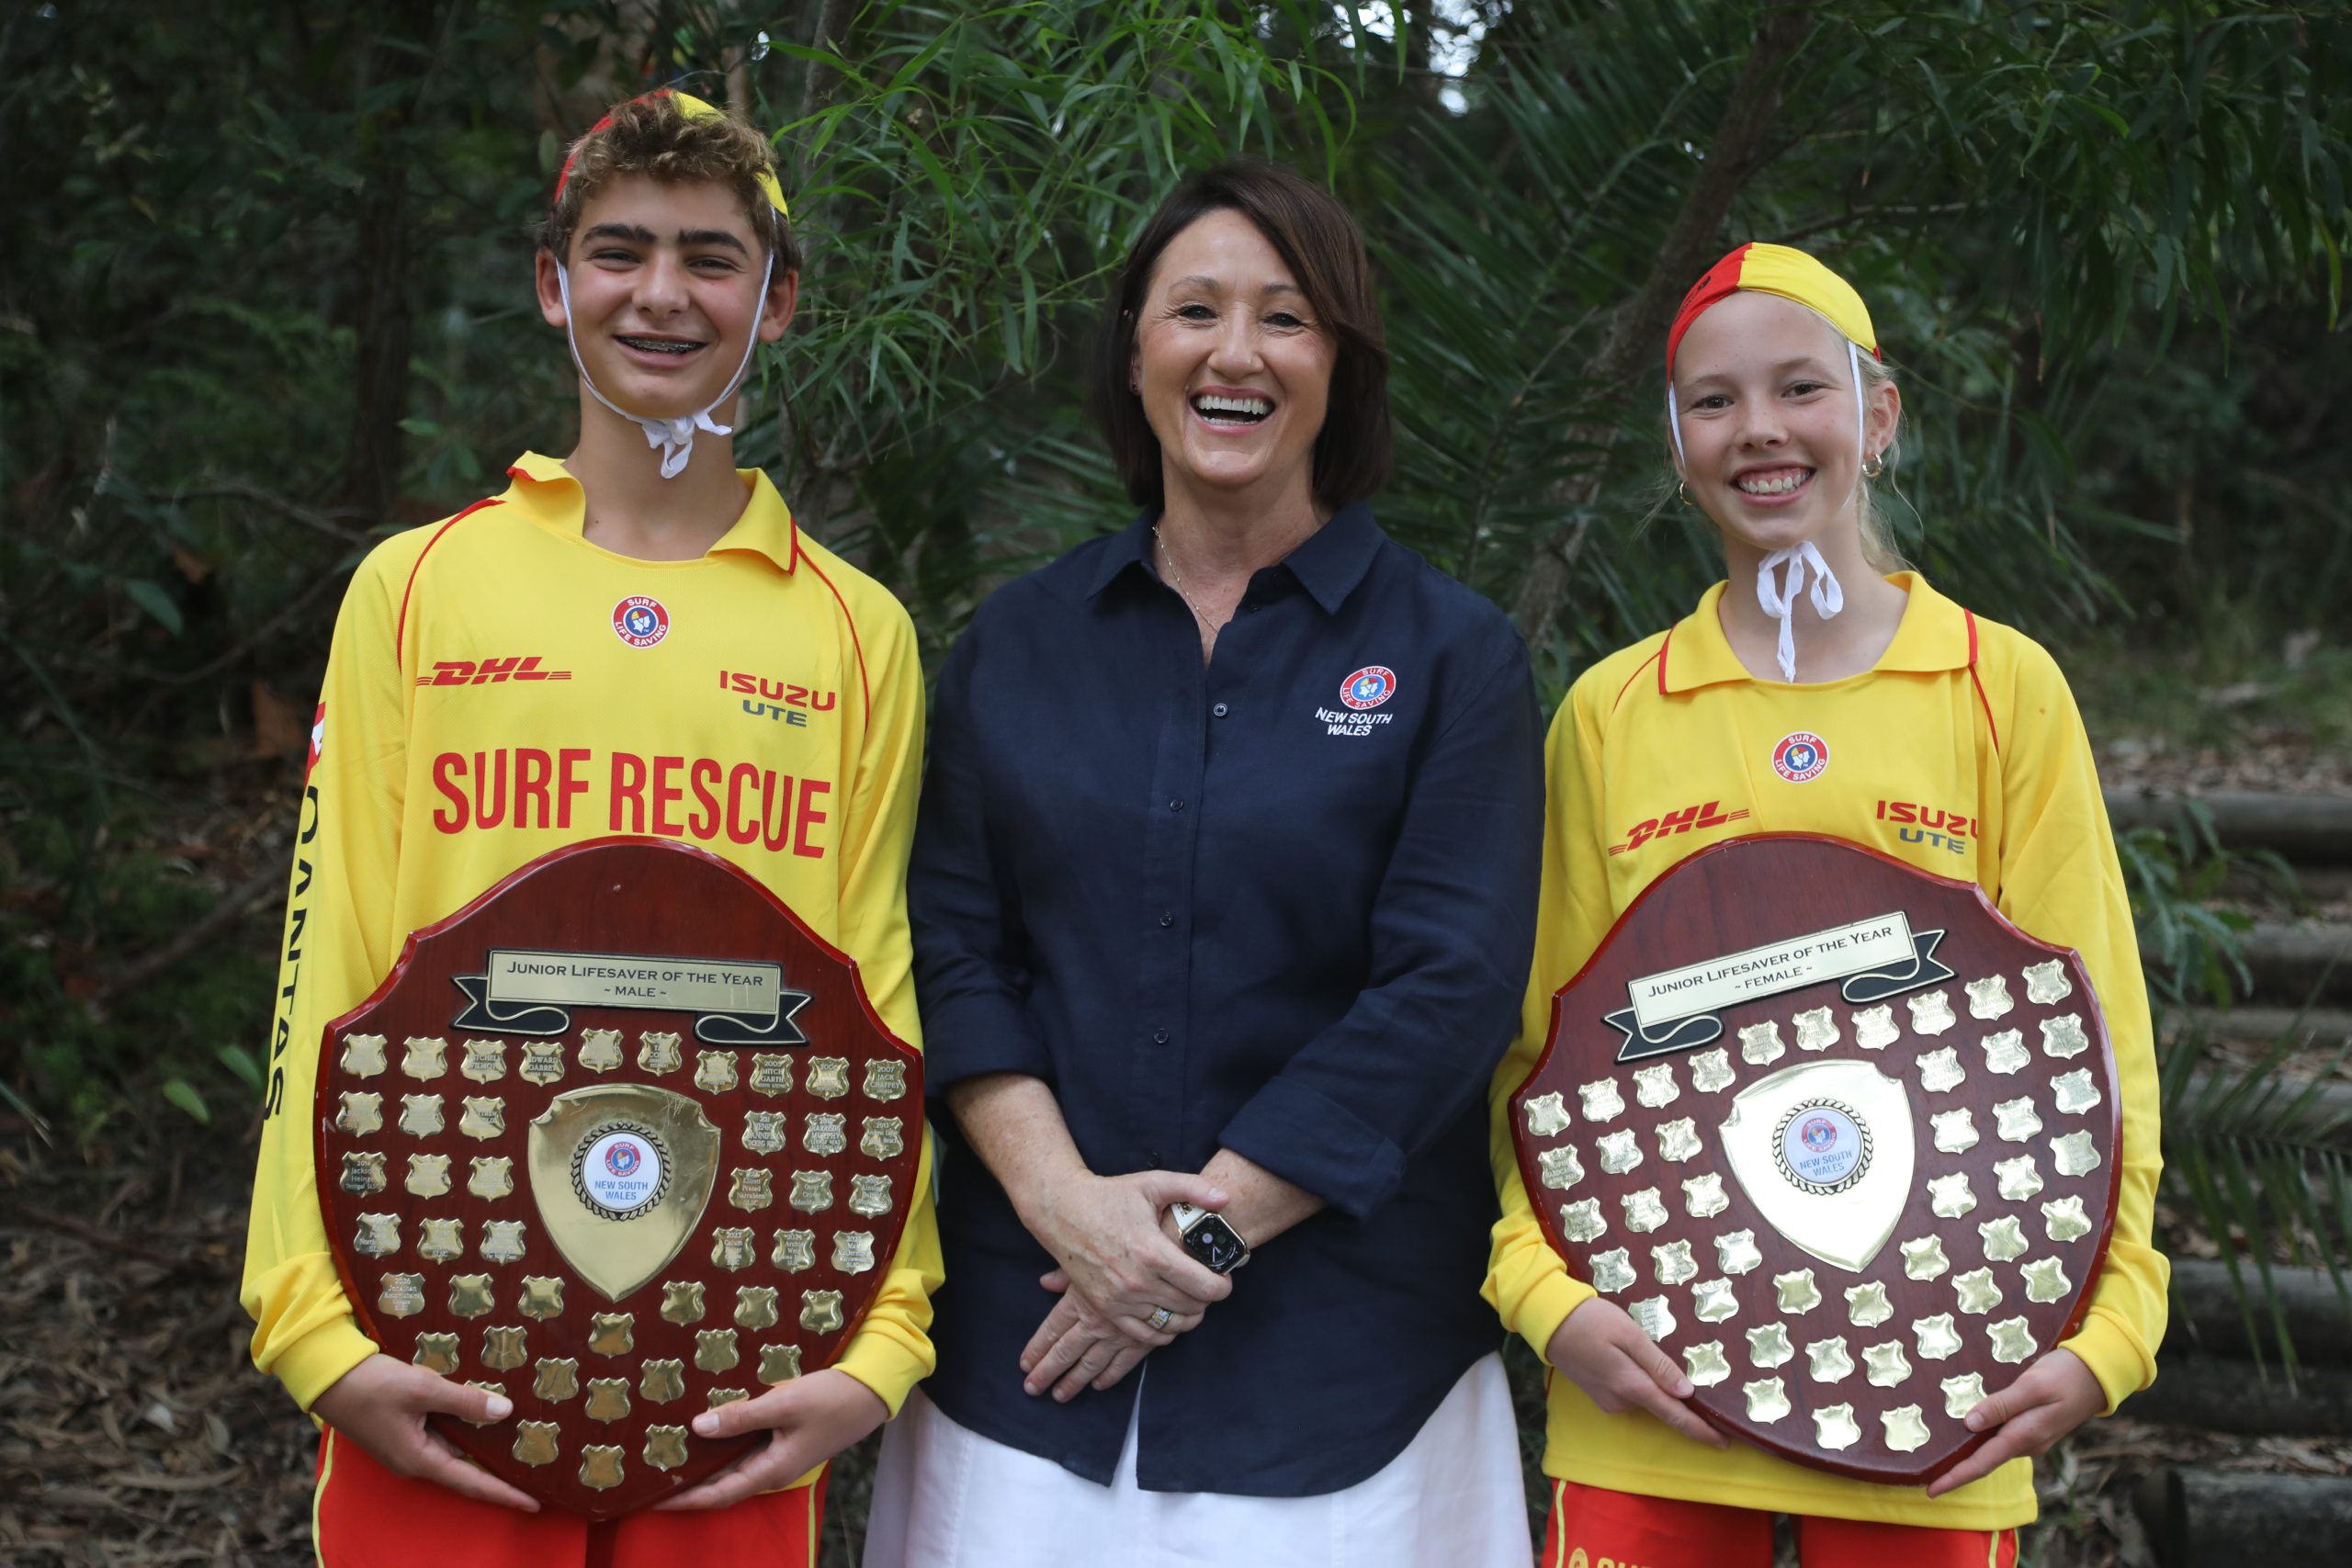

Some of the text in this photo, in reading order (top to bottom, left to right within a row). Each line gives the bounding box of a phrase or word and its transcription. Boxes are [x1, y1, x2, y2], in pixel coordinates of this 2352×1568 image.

[628, 598, 657, 607] SURF
[615, 621, 667, 646] LIFE SAVING
[432, 657, 549, 686] DHL
[1362, 668, 1389, 676] SURF
[719, 670, 835, 711] ISUZU
[1342, 687, 1391, 708] LIFE SAVING
[742, 699, 807, 728] UTE
[1315, 706, 1393, 724] NEW SOUTH
[1327, 724, 1372, 736] WALES
[1788, 734, 1817, 744] SURF
[1775, 758, 1826, 781] LIFE SAVING
[433, 748, 831, 859] SURF RESCUE
[1626, 801, 1728, 852] DHL
[1899, 828, 1965, 854] UTE
[1648, 927, 1893, 998] JUNIOR LIFESAVER OF THE YEAR
[507, 962, 763, 987] JUNIOR LIFESAVER OF THE YEAR
[1745, 966, 1803, 990] FEMALE
[615, 986, 656, 998] MALE
[1799, 1150, 1852, 1169] NEW SOUTH
[1813, 1162, 1845, 1176] WALES
[594, 1180, 649, 1190] NEW SOUTH
[605, 1191, 637, 1201] WALES
